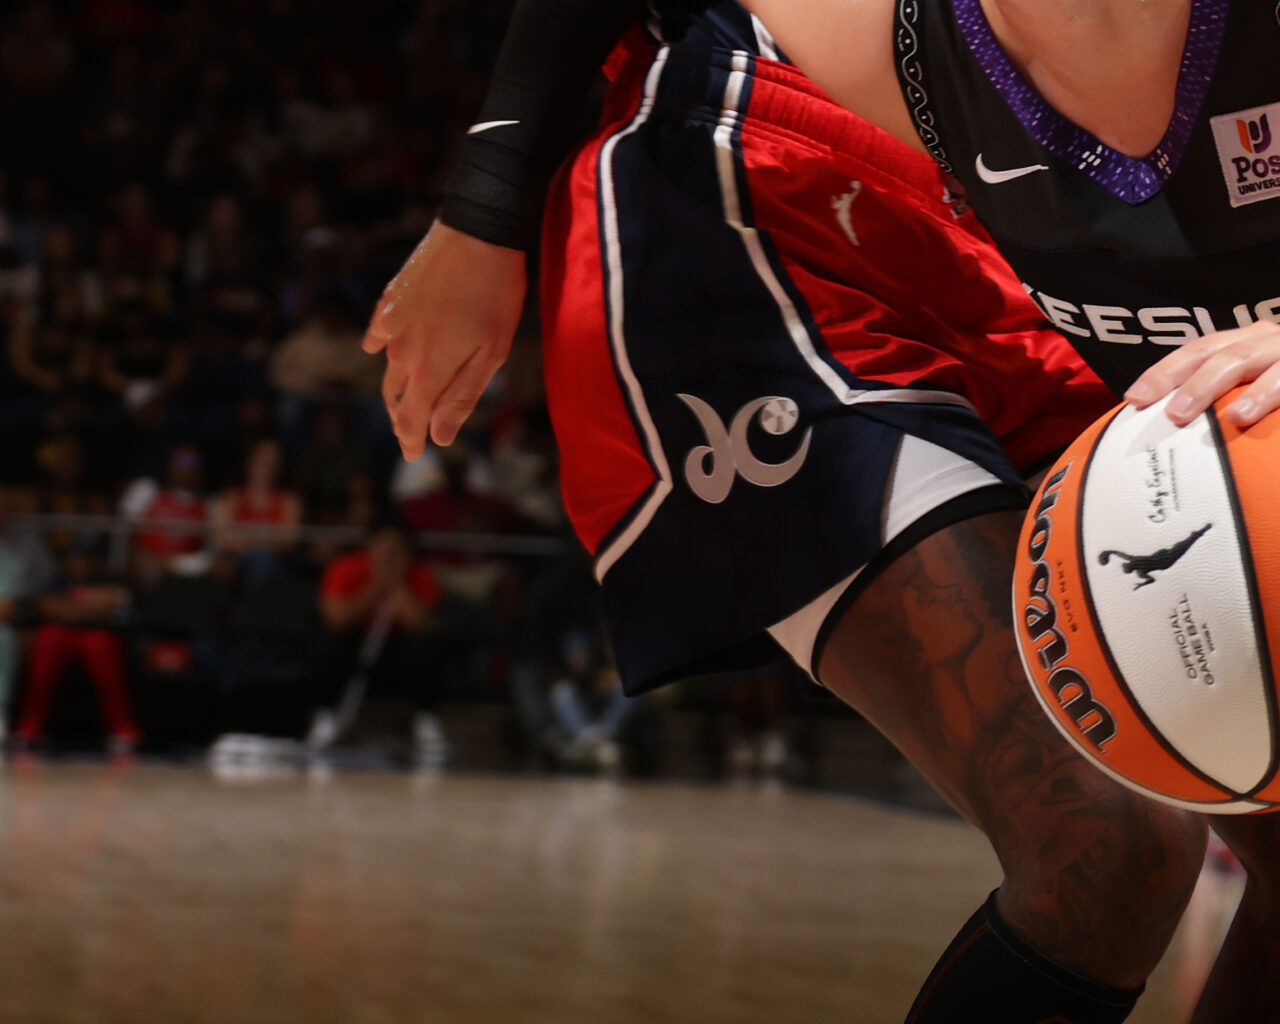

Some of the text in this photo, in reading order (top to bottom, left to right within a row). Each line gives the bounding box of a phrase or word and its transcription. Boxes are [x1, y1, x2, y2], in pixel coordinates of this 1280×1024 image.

[1168, 607, 1198, 680] OFFICIAL
[1178, 592, 1215, 686] GAME BALL
